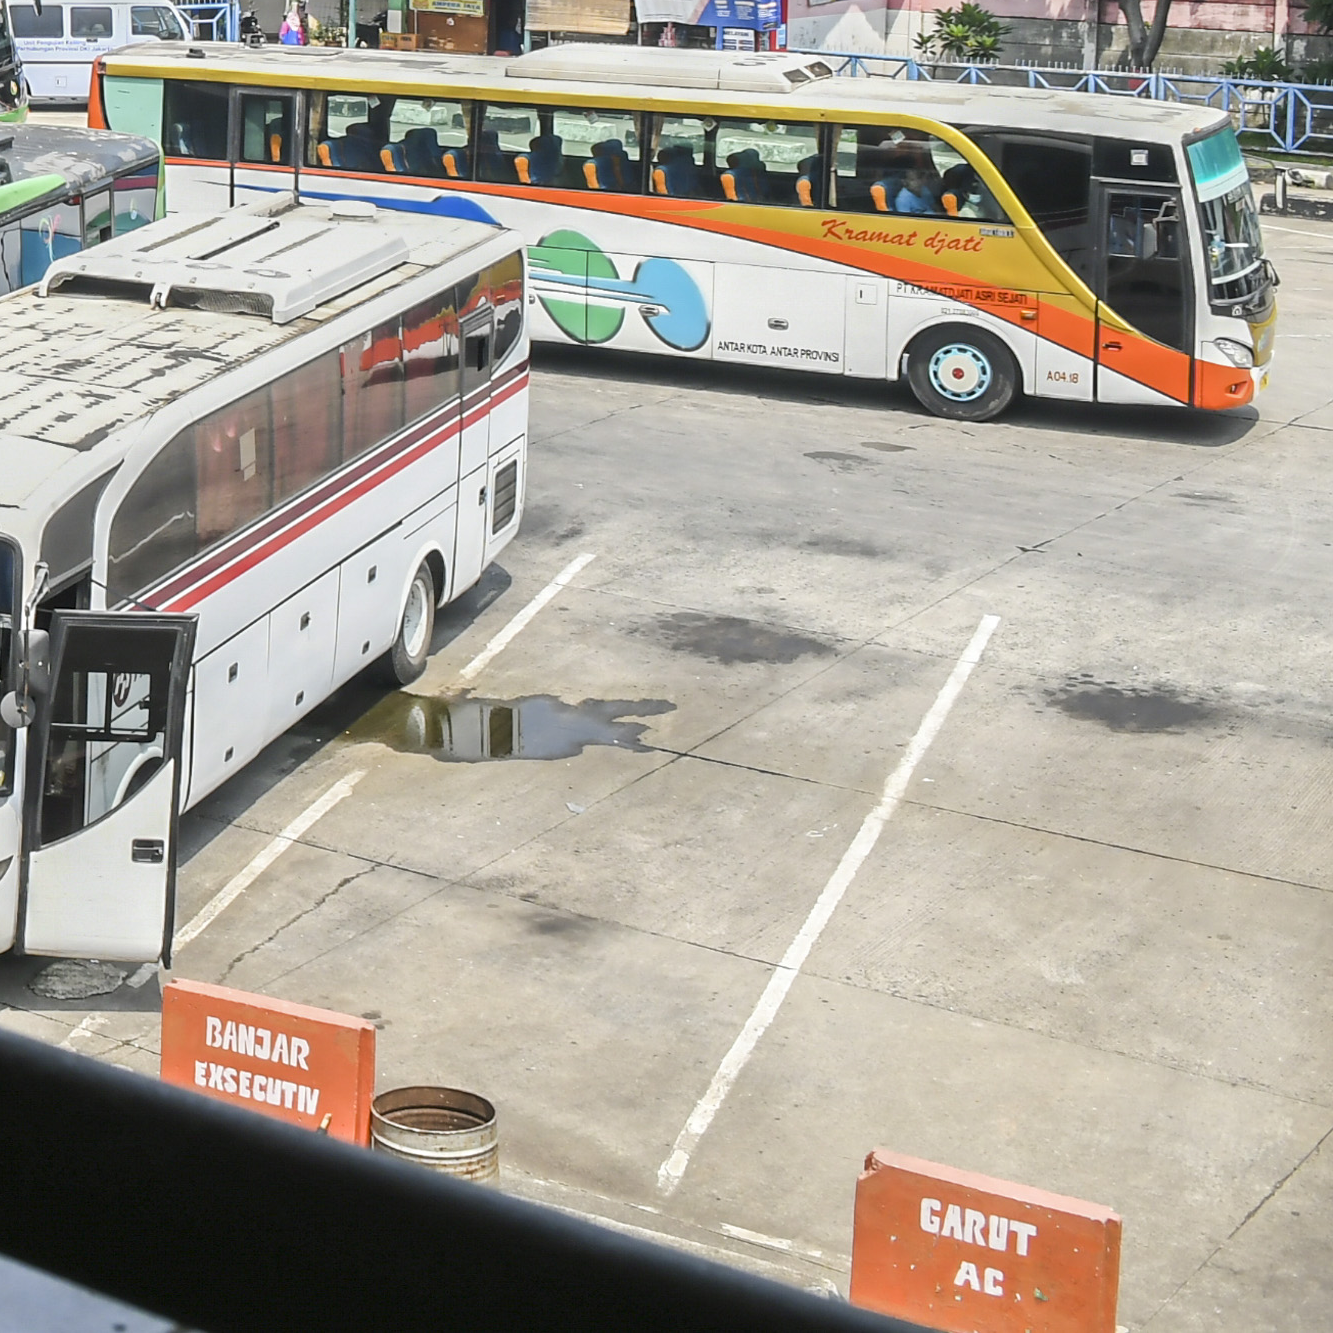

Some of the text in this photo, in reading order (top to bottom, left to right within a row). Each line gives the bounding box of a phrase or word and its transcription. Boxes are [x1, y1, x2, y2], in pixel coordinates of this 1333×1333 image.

[821, 219, 918, 246] Kramat
[924, 231, 985, 254] djati
[718, 341, 839, 362] ANTAR KOTA ANTAR PROVINSI
[206, 1016, 310, 1071] BANJAR
[194, 1060, 319, 1115] EXSECUTIV
[920, 1198, 1037, 1256] GARUT
[953, 1260, 1003, 1297] AC
